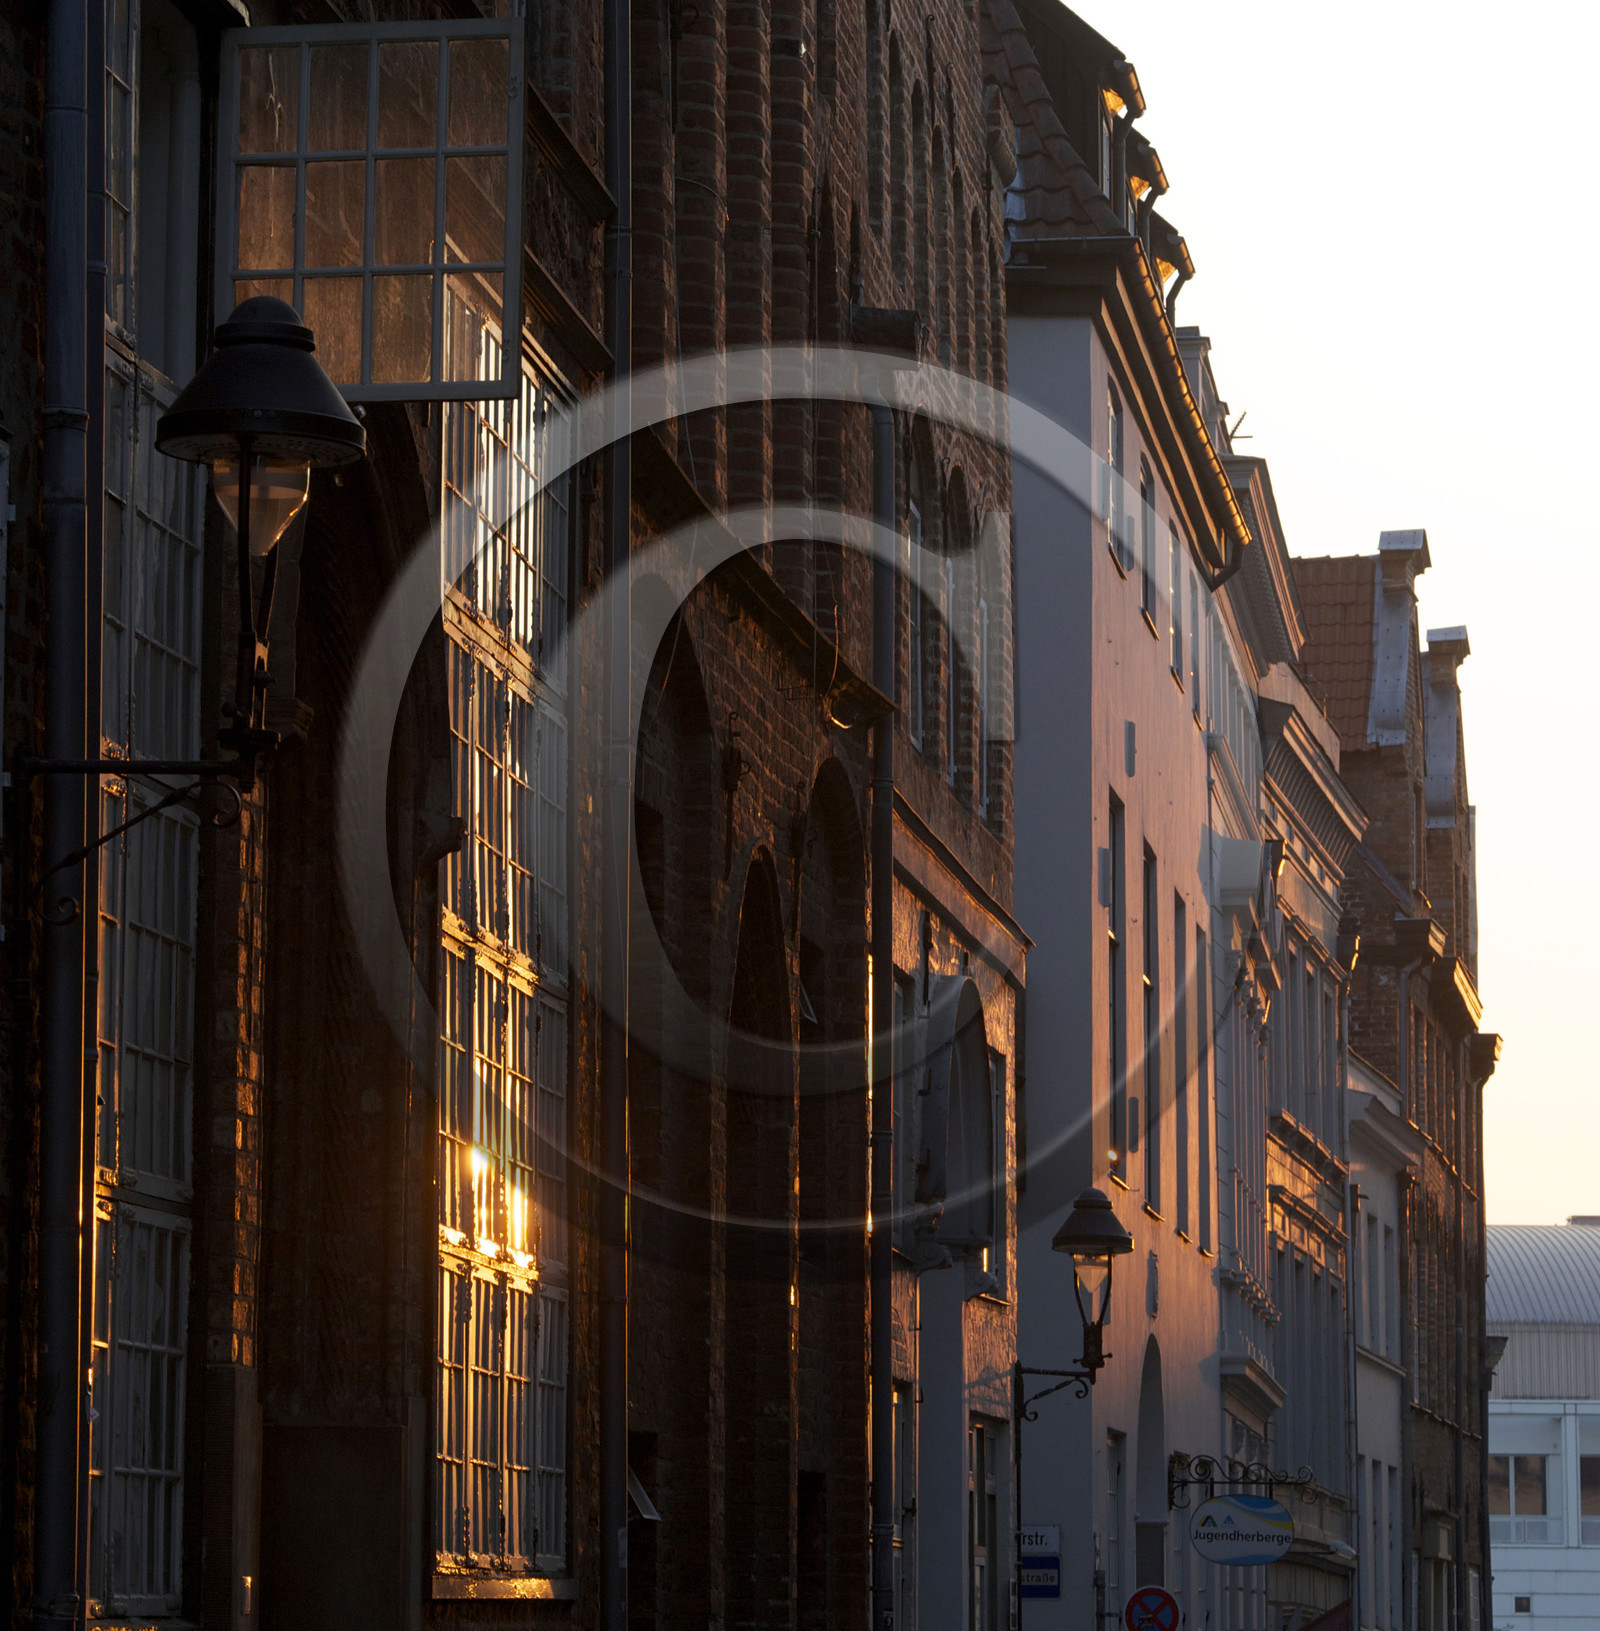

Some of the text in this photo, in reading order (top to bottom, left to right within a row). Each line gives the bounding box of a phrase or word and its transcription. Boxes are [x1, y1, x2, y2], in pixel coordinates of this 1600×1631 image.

[1022, 1531, 1048, 1546] rstr.
[1193, 1529, 1291, 1546] Jugendherberge
[1020, 1572, 1056, 1583] straße
